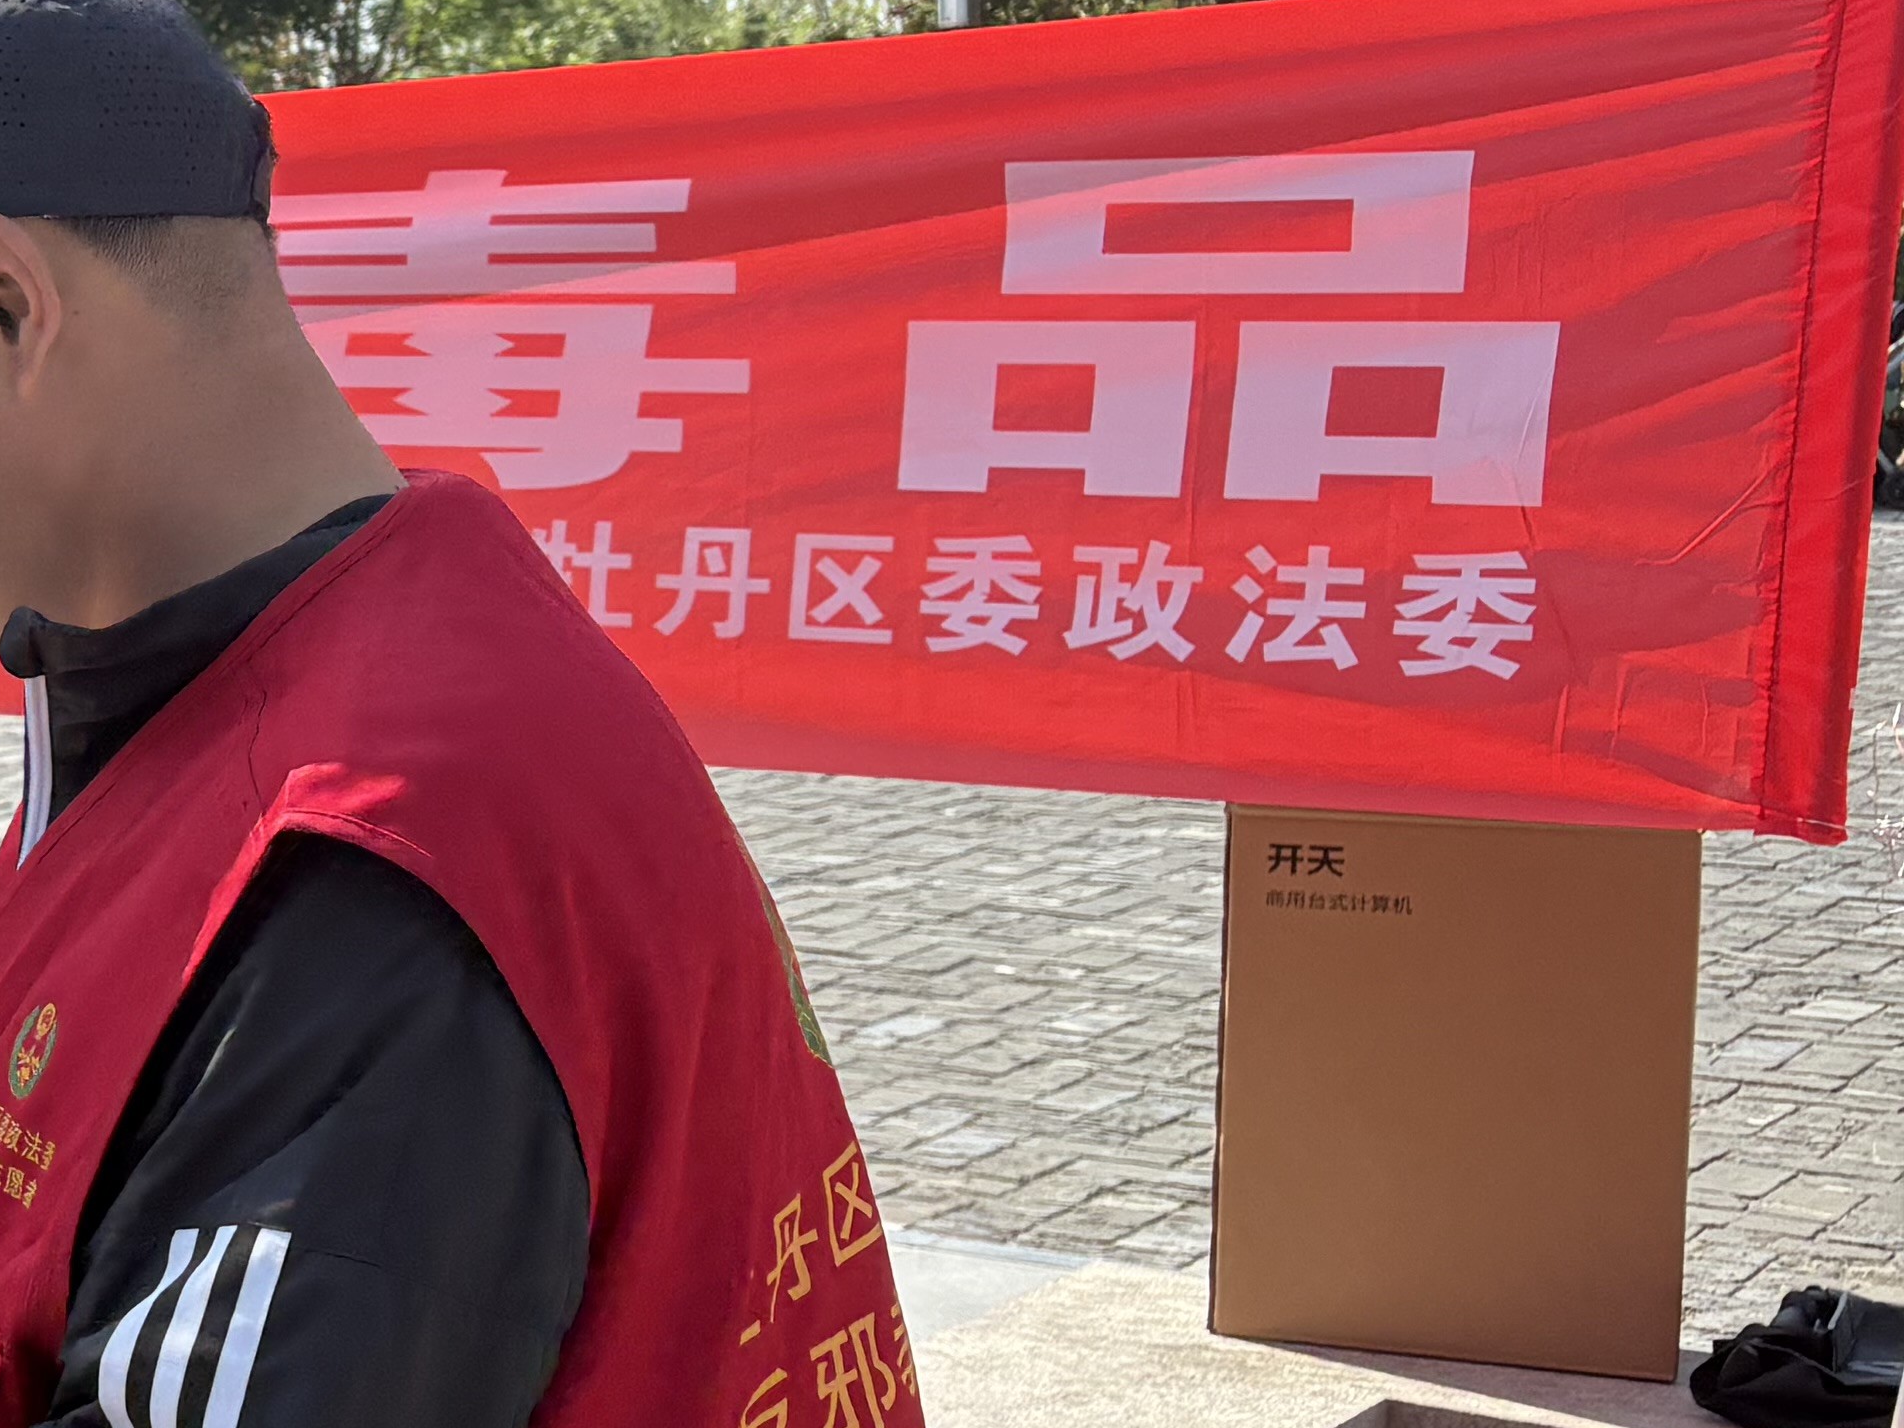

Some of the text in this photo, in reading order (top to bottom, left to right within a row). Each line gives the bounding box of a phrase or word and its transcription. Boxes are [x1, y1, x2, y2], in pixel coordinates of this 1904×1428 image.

[530, 519, 1536, 679] 牡丹区委政法委
[1266, 889, 1413, 915] 商用台式计算机
[1268, 843, 1345, 877] 开天
[739, 1141, 883, 1347] 丹区
